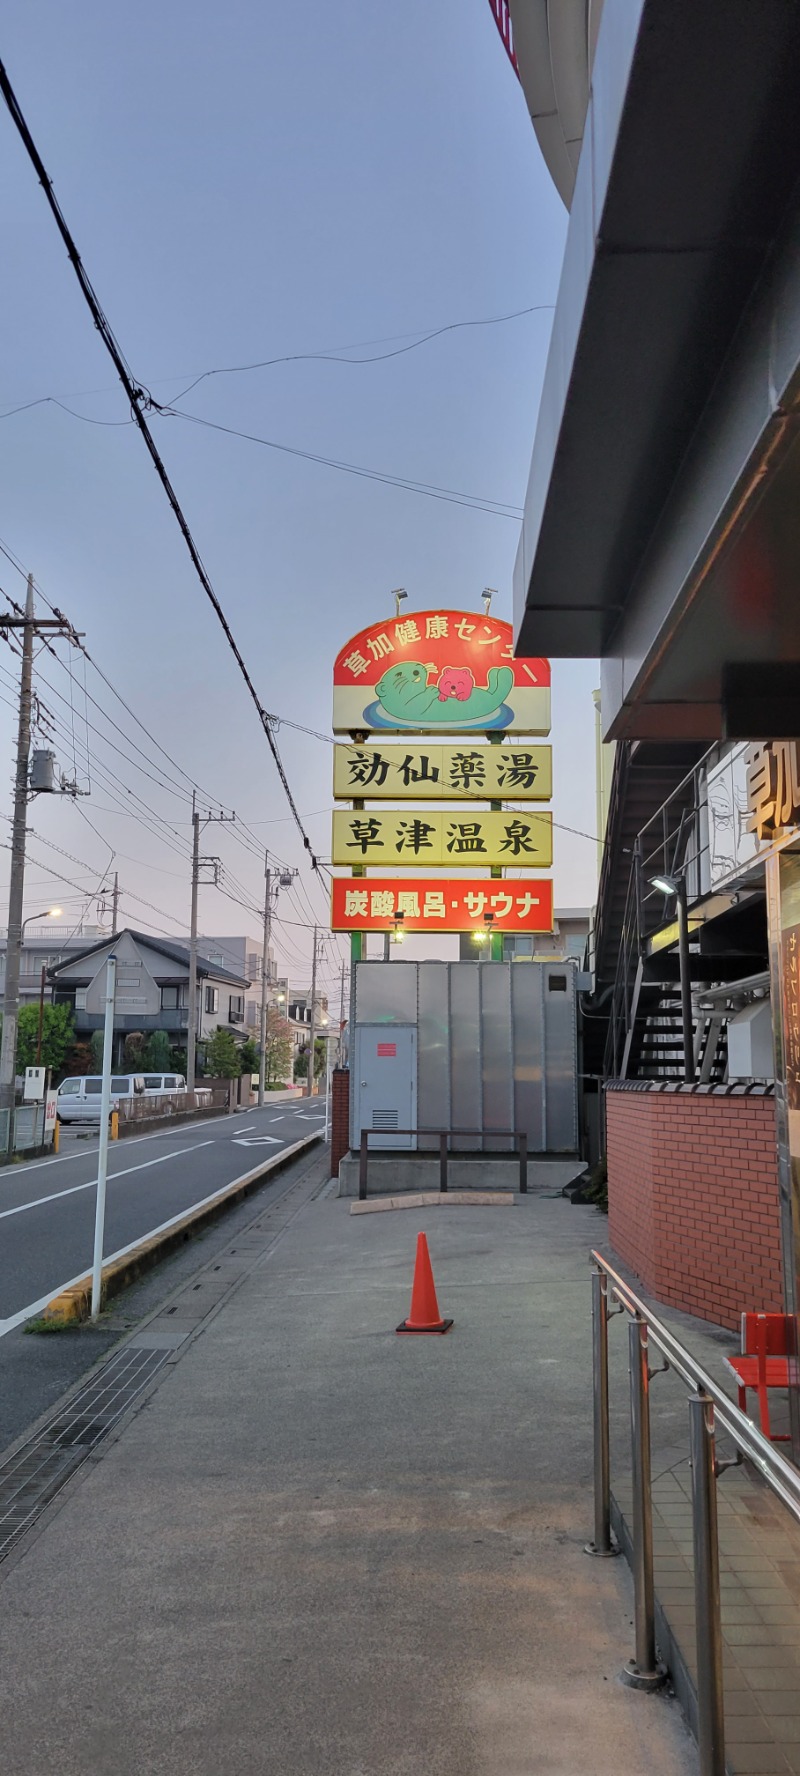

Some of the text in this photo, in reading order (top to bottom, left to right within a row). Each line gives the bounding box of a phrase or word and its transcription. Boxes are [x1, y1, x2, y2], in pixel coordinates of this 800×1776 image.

[347, 751, 539, 790] 効仙薬湯
[345, 818, 540, 855] 草津温泉
